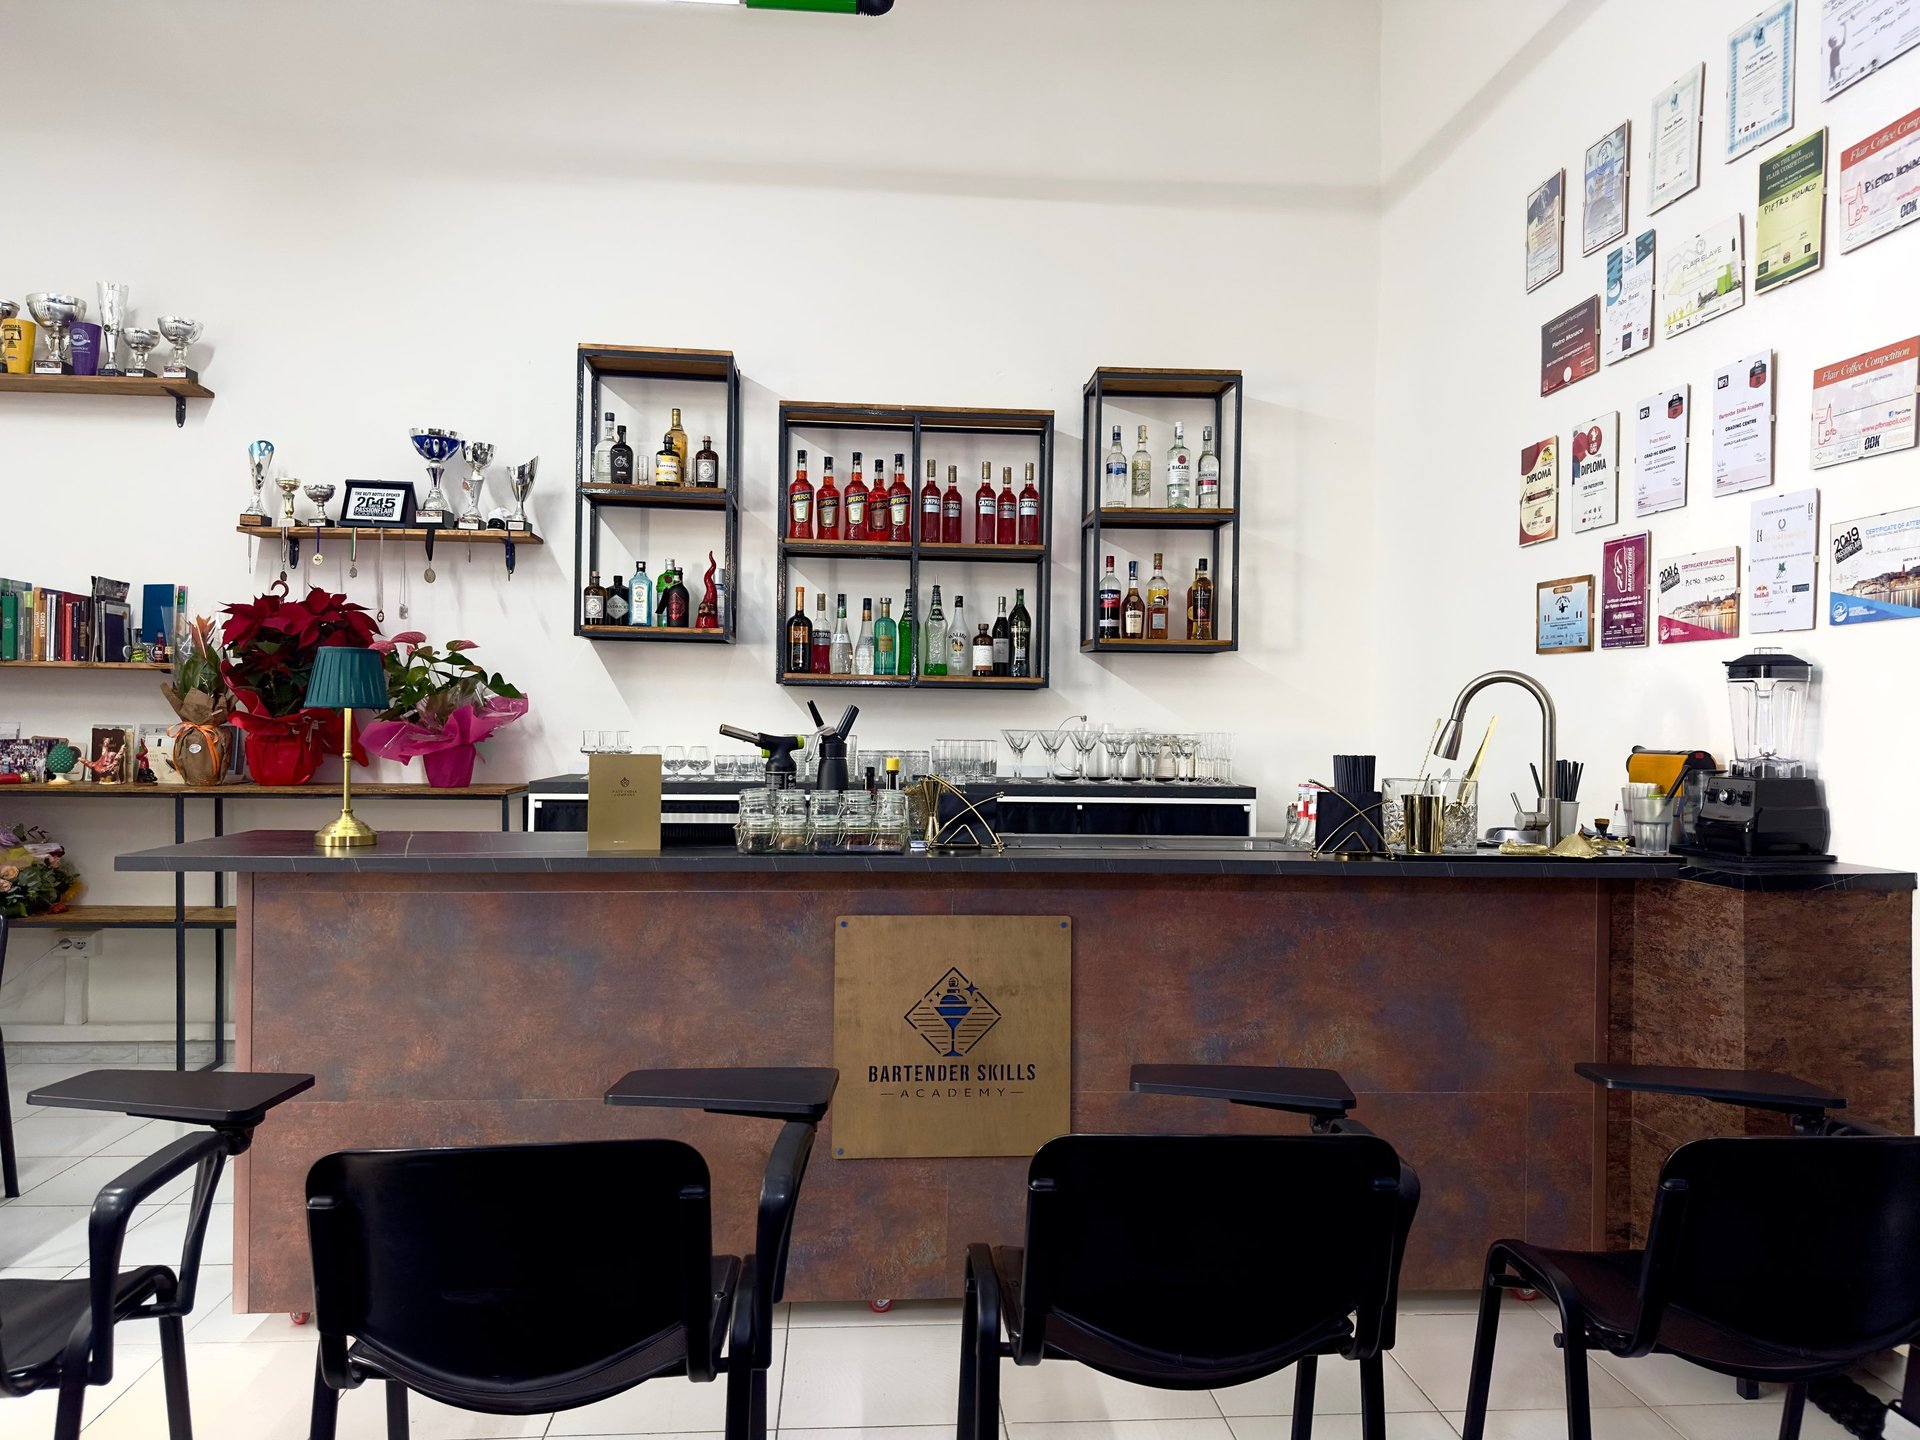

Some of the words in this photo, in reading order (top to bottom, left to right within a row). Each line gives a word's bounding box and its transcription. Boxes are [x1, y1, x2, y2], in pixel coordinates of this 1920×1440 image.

[1850, 144, 1870, 162] Flair
[1871, 129, 1896, 150] Coffee
[1766, 168, 1780, 181] FLAIR
[1780, 151, 1815, 176] COMPETITION
[1772, 162, 1780, 170] ON
[1780, 156, 1791, 167] THE
[1790, 149, 1802, 162] BOX
[1864, 171, 1895, 193] PIETRO
[1764, 197, 1789, 215] PIETRO
[1791, 183, 1817, 202] MONACO
[1822, 371, 1840, 382] Flair
[1840, 362, 1863, 376] Coffee
[1863, 346, 1910, 369] Competition
[1718, 408, 1736, 421] Bartender
[1736, 405, 1747, 415] Skills
[1747, 401, 1764, 413] Academy
[1725, 422, 1742, 433] GRADING
[1742, 418, 1757, 428] CENTRE
[1864, 434, 1881, 450] ODK
[1581, 458, 1607, 476] DIPLOMA
[1526, 467, 1552, 485] DIPLOMA
[791, 492, 811, 501] APEROL
[819, 498, 838, 508] APEROL
[847, 494, 865, 504] APEROL
[890, 496, 909, 505] APEROL
[355, 506, 393, 514] PASSIONFLAIR
[1865, 524, 1897, 536] CERTIFICATE
[1897, 521, 1906, 530] OF
[1833, 527, 1860, 553] 2019
[1681, 561, 1703, 570] CERTIFICATE
[1709, 556, 1736, 565] ATTENDANCE
[1659, 563, 1679, 585] 2016
[1685, 578, 1701, 587] PIETRO
[1705, 574, 1726, 584] MONACO
[948, 631, 968, 641] MALIBU
[868, 1064, 970, 1082] BARTENDER
[977, 1063, 1036, 1081] SKILLS
[899, 1087, 1006, 1098] ACADEMY
